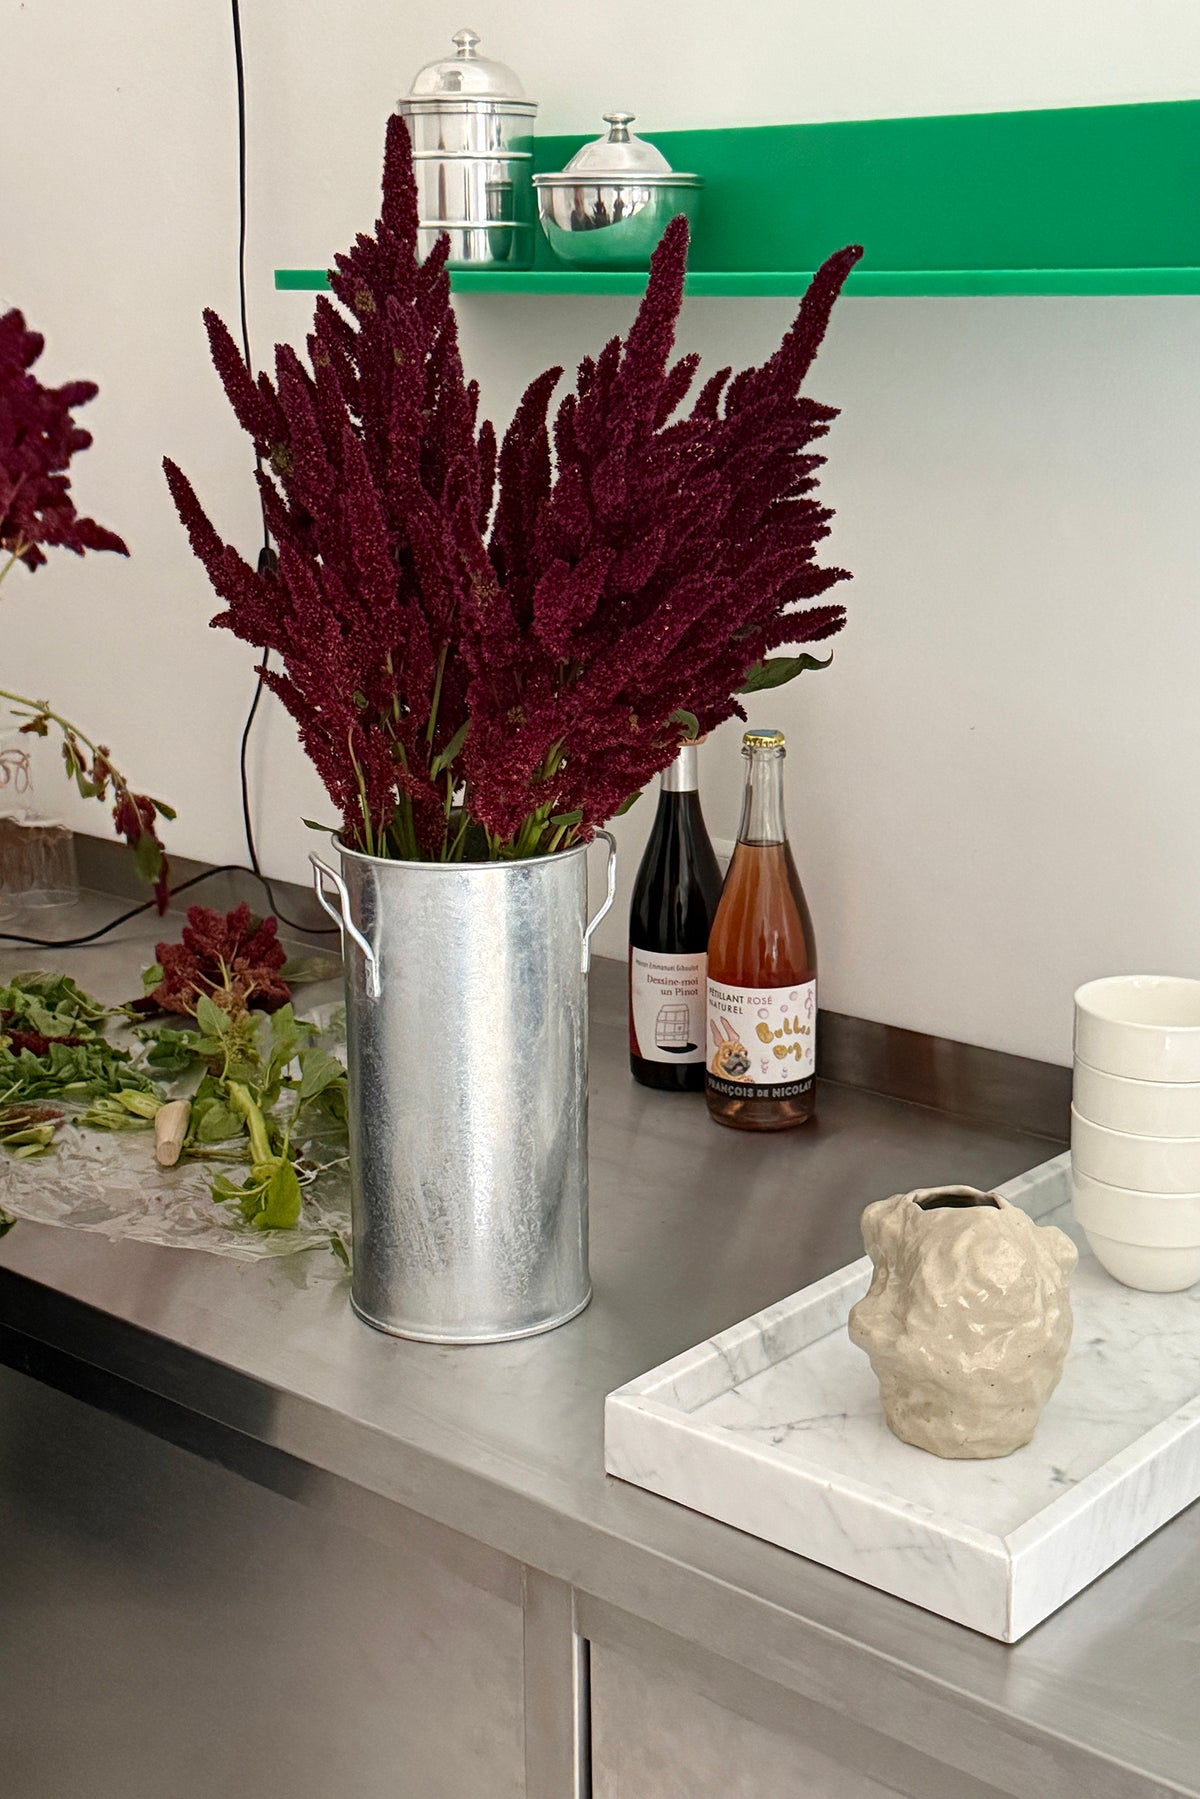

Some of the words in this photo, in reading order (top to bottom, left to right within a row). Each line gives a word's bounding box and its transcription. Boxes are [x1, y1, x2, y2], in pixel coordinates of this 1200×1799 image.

[647, 974, 699, 986] Dessine-moi
[675, 988, 698, 996] Pinot
[708, 987, 744, 1004] PÉTILLANT
[746, 995, 773, 1005] ROSÉ
[708, 998, 744, 1014] NATUREL
[707, 1077, 754, 1097] FRANÇOIS
[772, 1080, 812, 1098] NICOLAY
